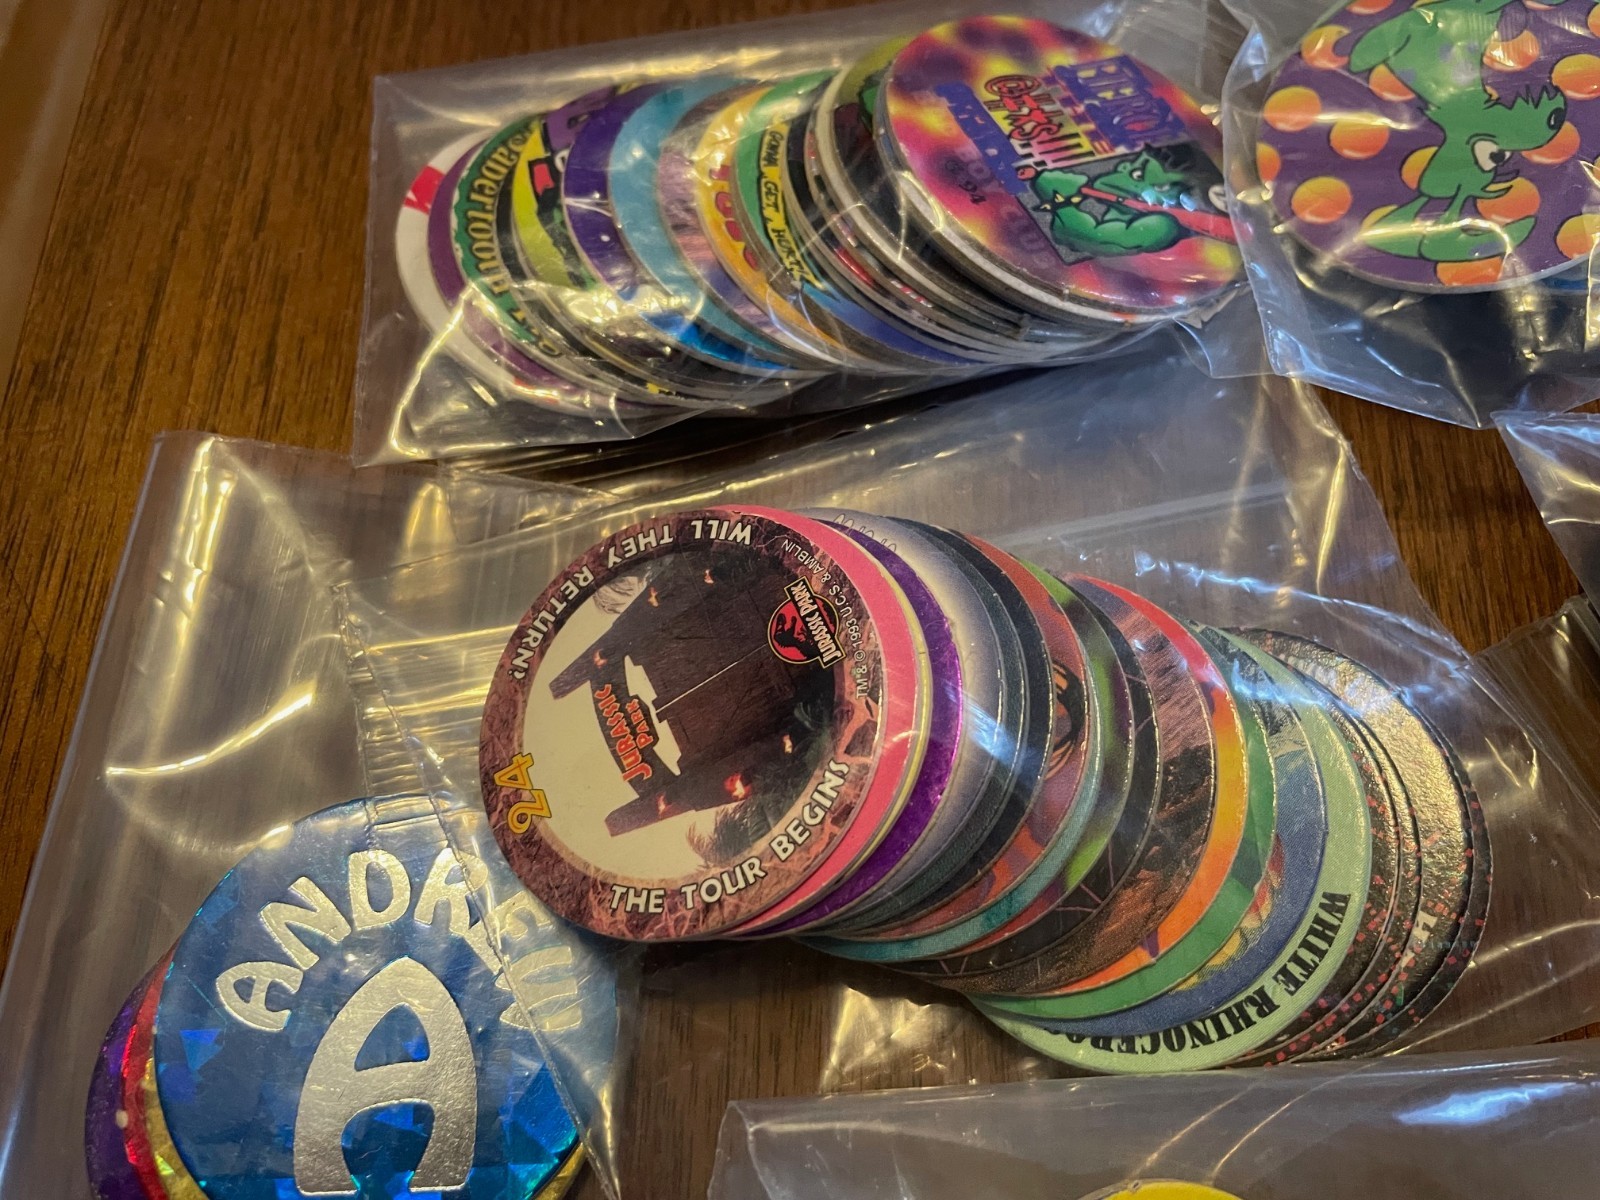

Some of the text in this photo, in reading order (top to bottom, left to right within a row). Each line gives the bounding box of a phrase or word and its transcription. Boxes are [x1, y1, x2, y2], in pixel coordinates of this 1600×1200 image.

[763, 180, 780, 213] GET
[781, 538, 825, 575] AMBLIN
[820, 572, 832, 583] &
[508, 519, 752, 681] WILL THEY RETURN?
[790, 581, 842, 662] JURASSIC PARK
[828, 581, 853, 618] U.C.S.
[845, 618, 862, 648] 1993
[624, 700, 655, 750] PARK
[855, 679, 869, 699] TM
[594, 683, 653, 783] JURASSIC
[493, 752, 552, 835] 24
[610, 760, 850, 914] THE TOUR BEGINS
[216, 847, 583, 1032] ANDREW
[1272, 891, 1352, 997] WHITE
[293, 956, 478, 1196] A
